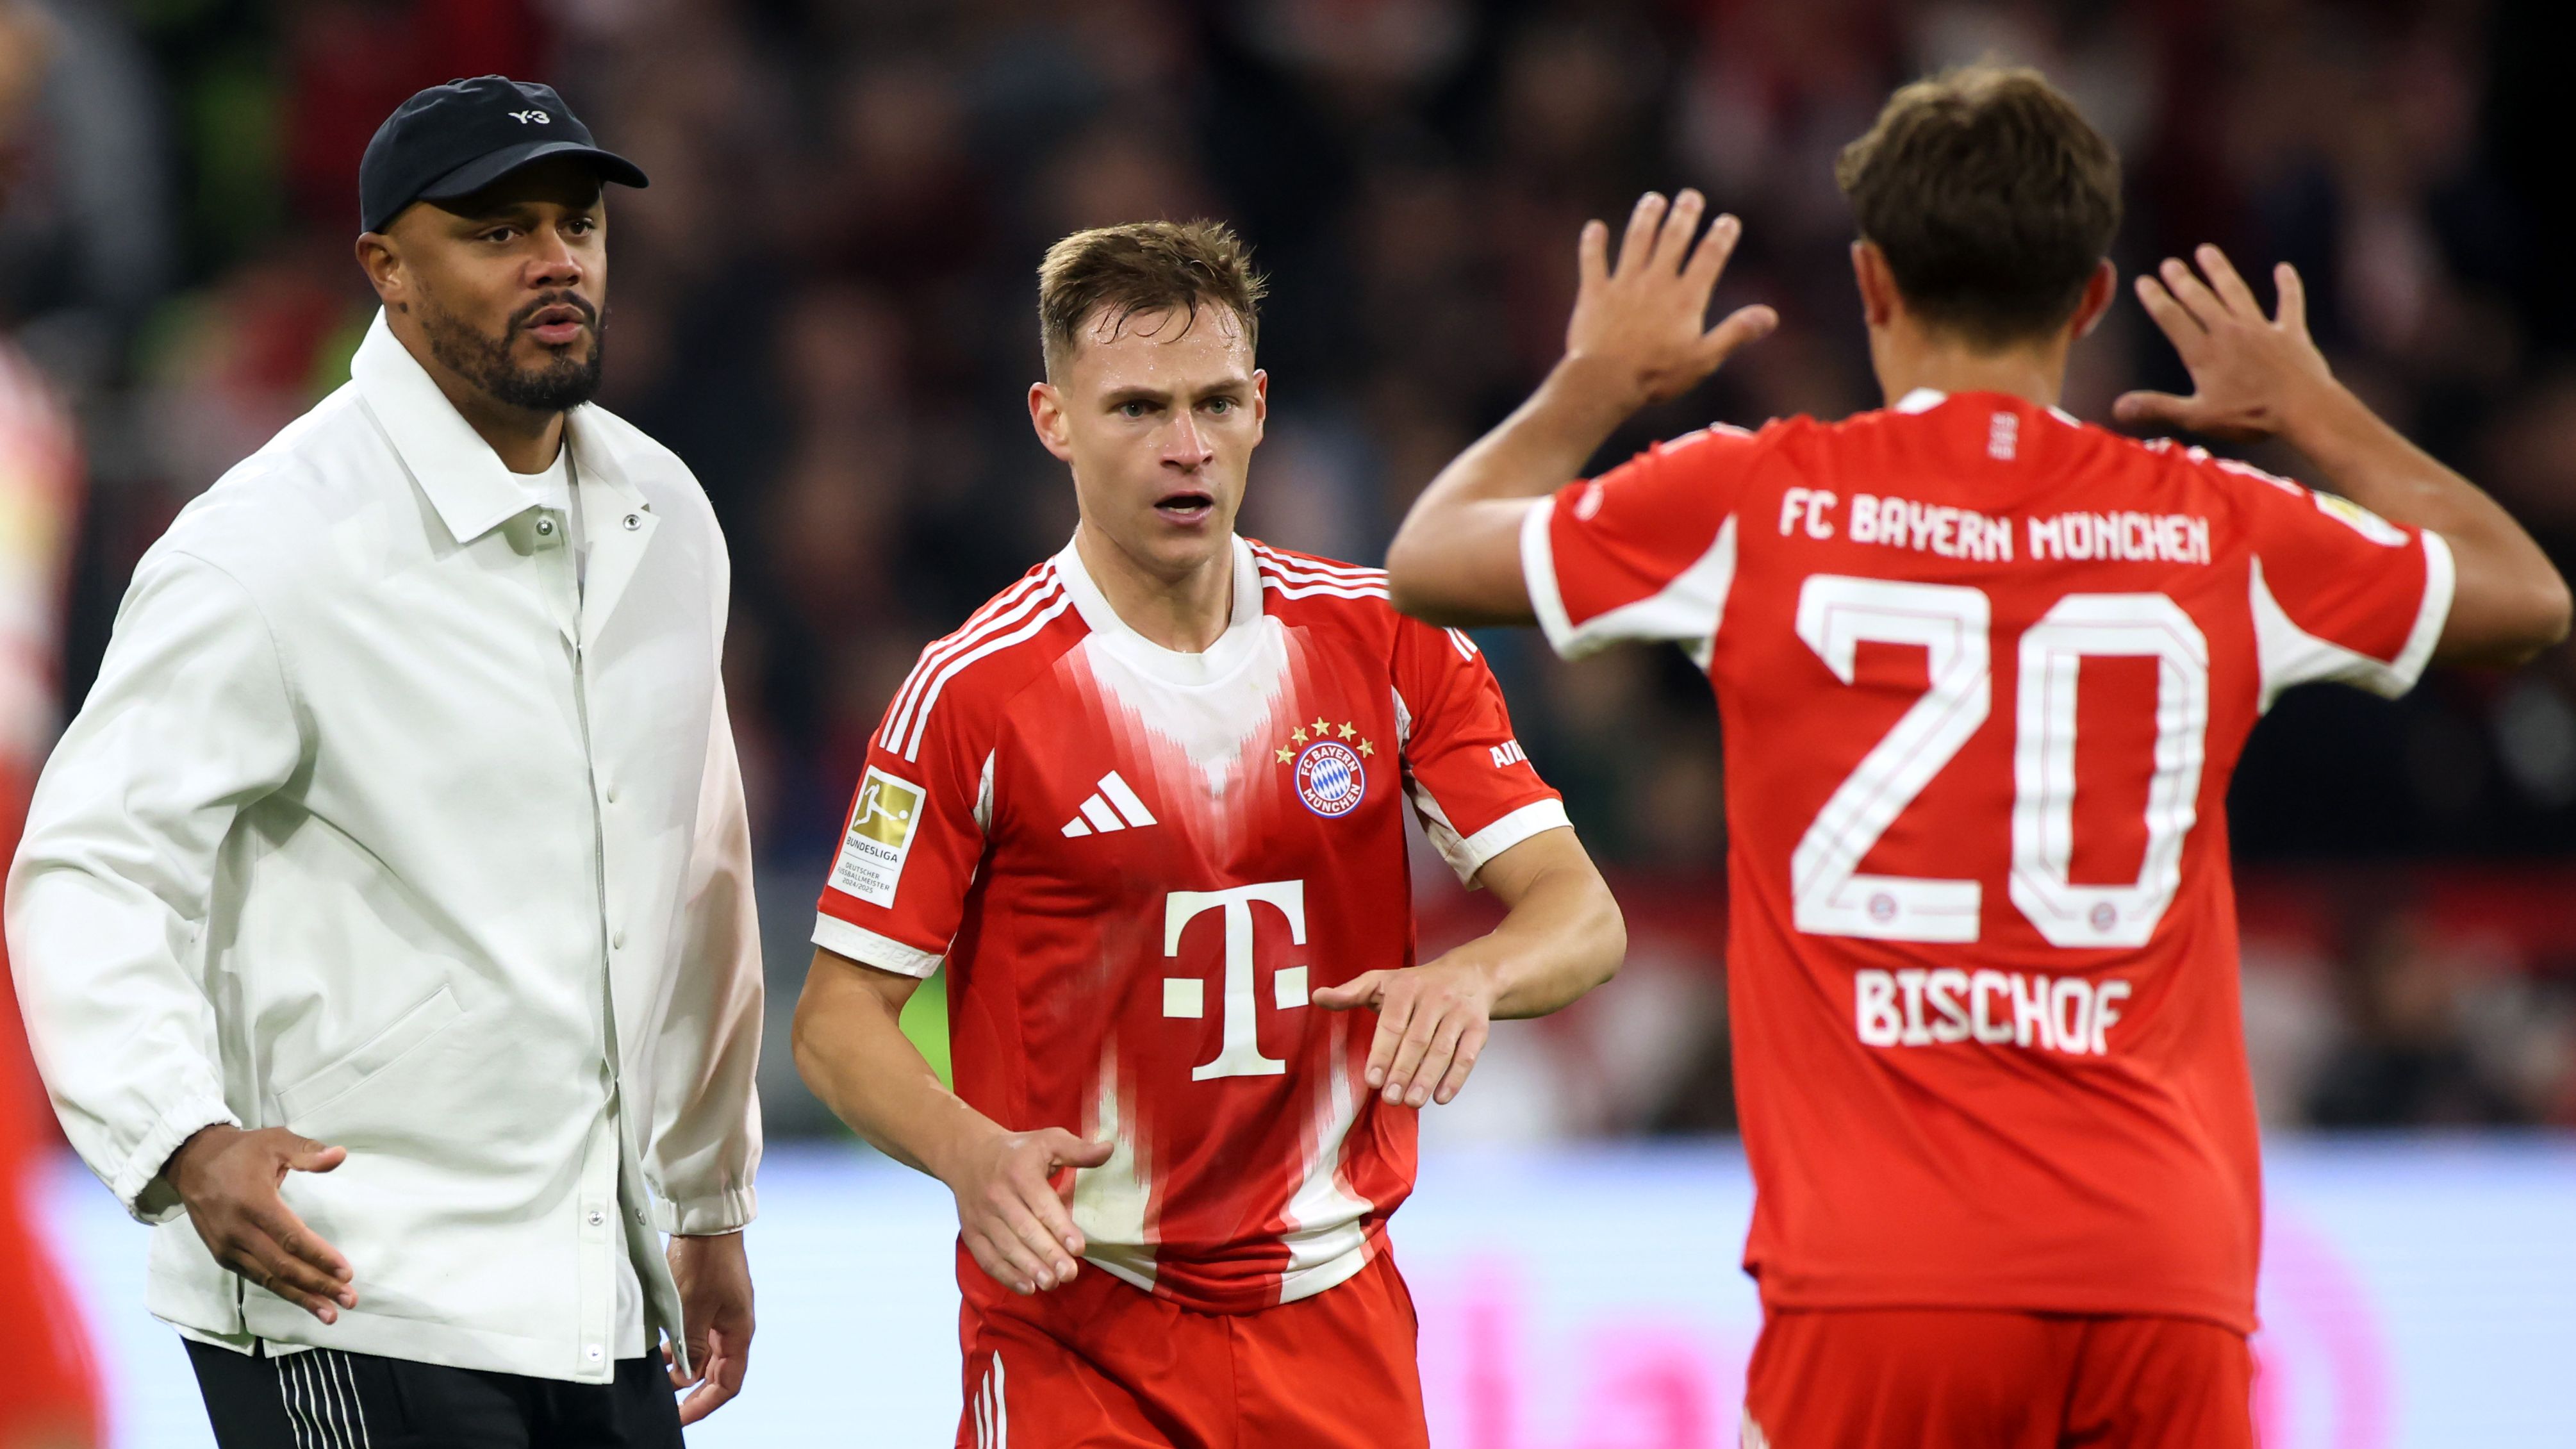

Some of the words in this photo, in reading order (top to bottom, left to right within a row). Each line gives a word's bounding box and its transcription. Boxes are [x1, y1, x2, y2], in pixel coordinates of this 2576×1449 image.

[508, 110, 550, 124] Y-3
[1779, 487, 1837, 540] FC
[1849, 493, 2013, 561] BAYERN
[1301, 759, 1313, 776] FC
[1311, 747, 1358, 772] BAYERN
[1791, 573, 2209, 948] 20
[846, 836, 898, 863] BUNDESLIGA
[842, 877, 873, 893] 2024/2025
[845, 862, 880, 879] DEUTSCHER
[1164, 879, 1309, 1081] T
[1855, 969, 2131, 1056] BISCHOF
